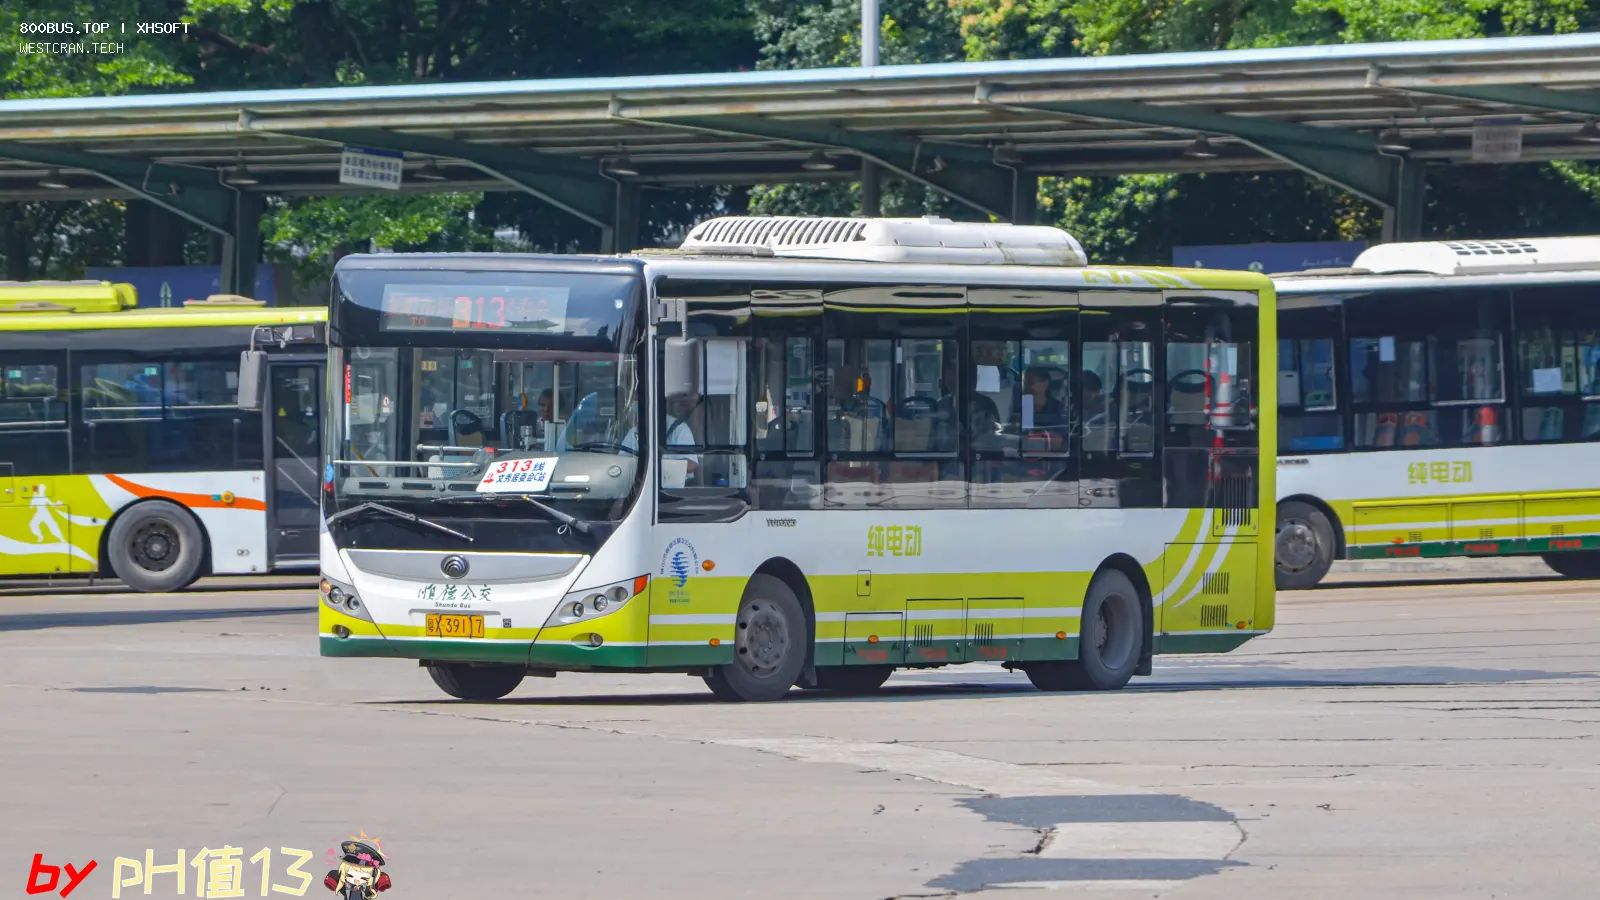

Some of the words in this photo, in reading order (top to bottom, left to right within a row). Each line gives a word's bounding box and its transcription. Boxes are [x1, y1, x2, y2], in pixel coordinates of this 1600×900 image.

[453, 296, 505, 328] 313
[1408, 461, 1473, 484] 纯电动
[867, 525, 922, 557] 纯电动
